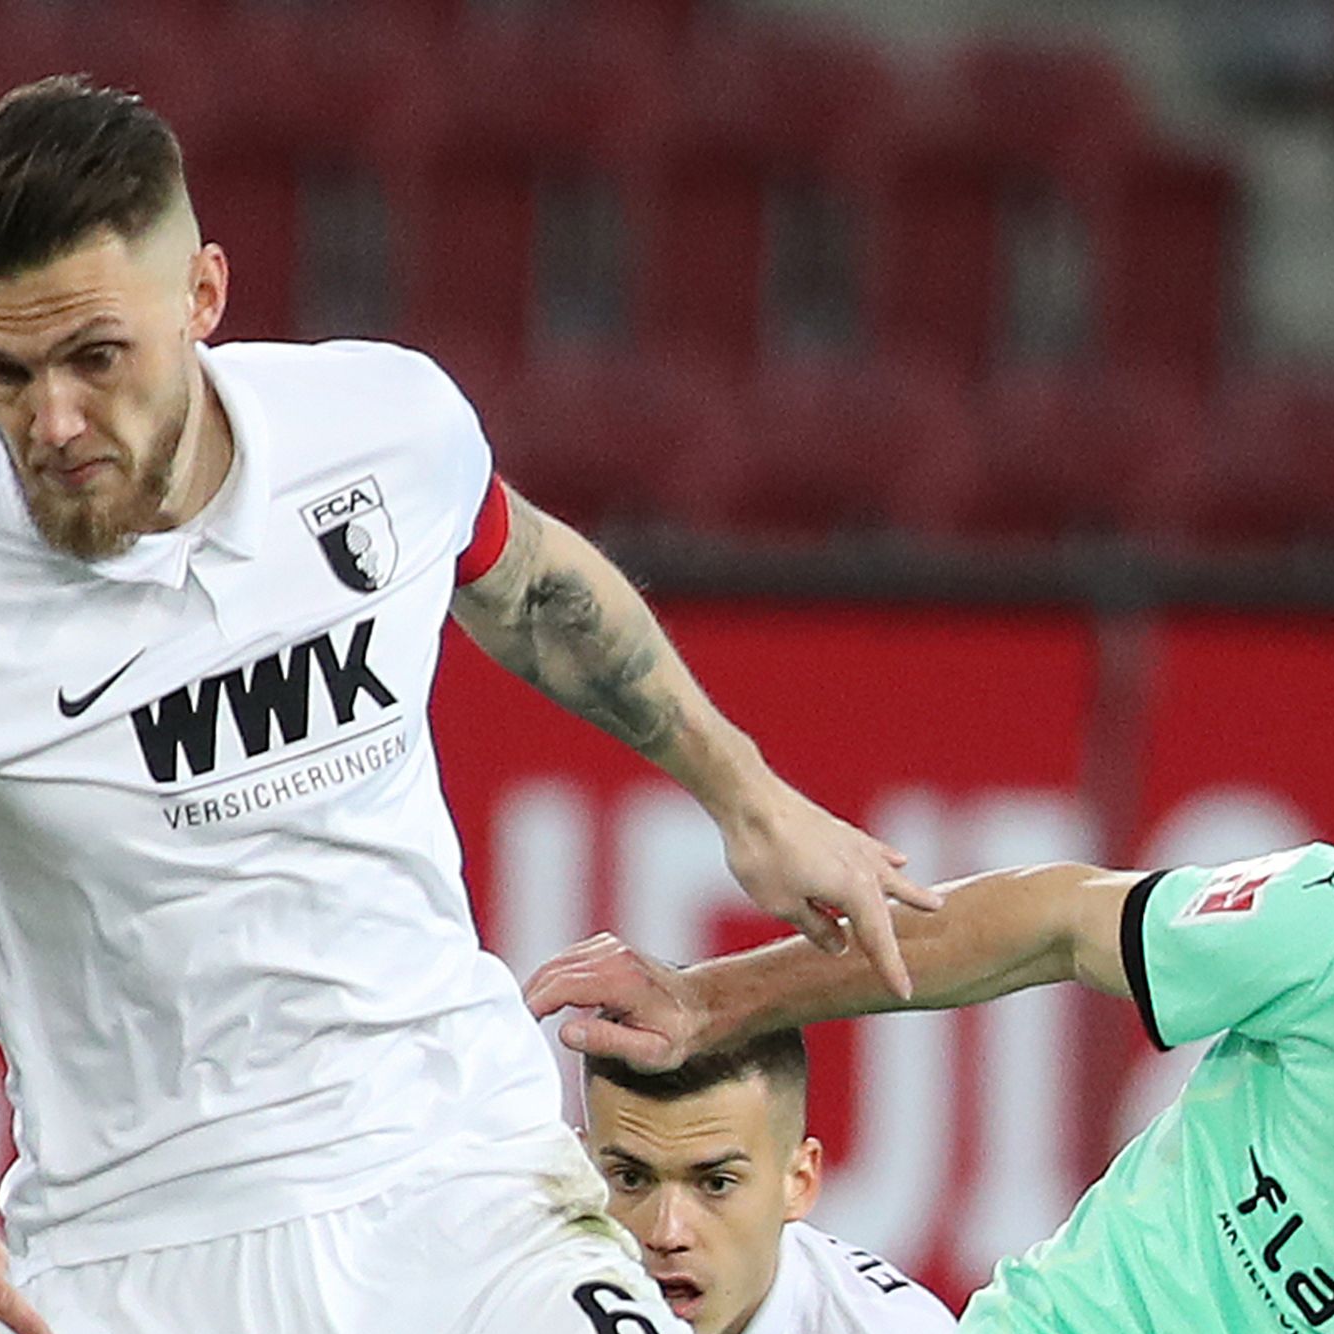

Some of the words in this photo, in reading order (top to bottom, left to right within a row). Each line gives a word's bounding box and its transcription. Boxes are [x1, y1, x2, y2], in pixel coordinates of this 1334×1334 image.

[312, 488, 373, 527] FCA
[130, 617, 399, 784] WWK
[163, 732, 407, 830] VERSICHERUNGEN
